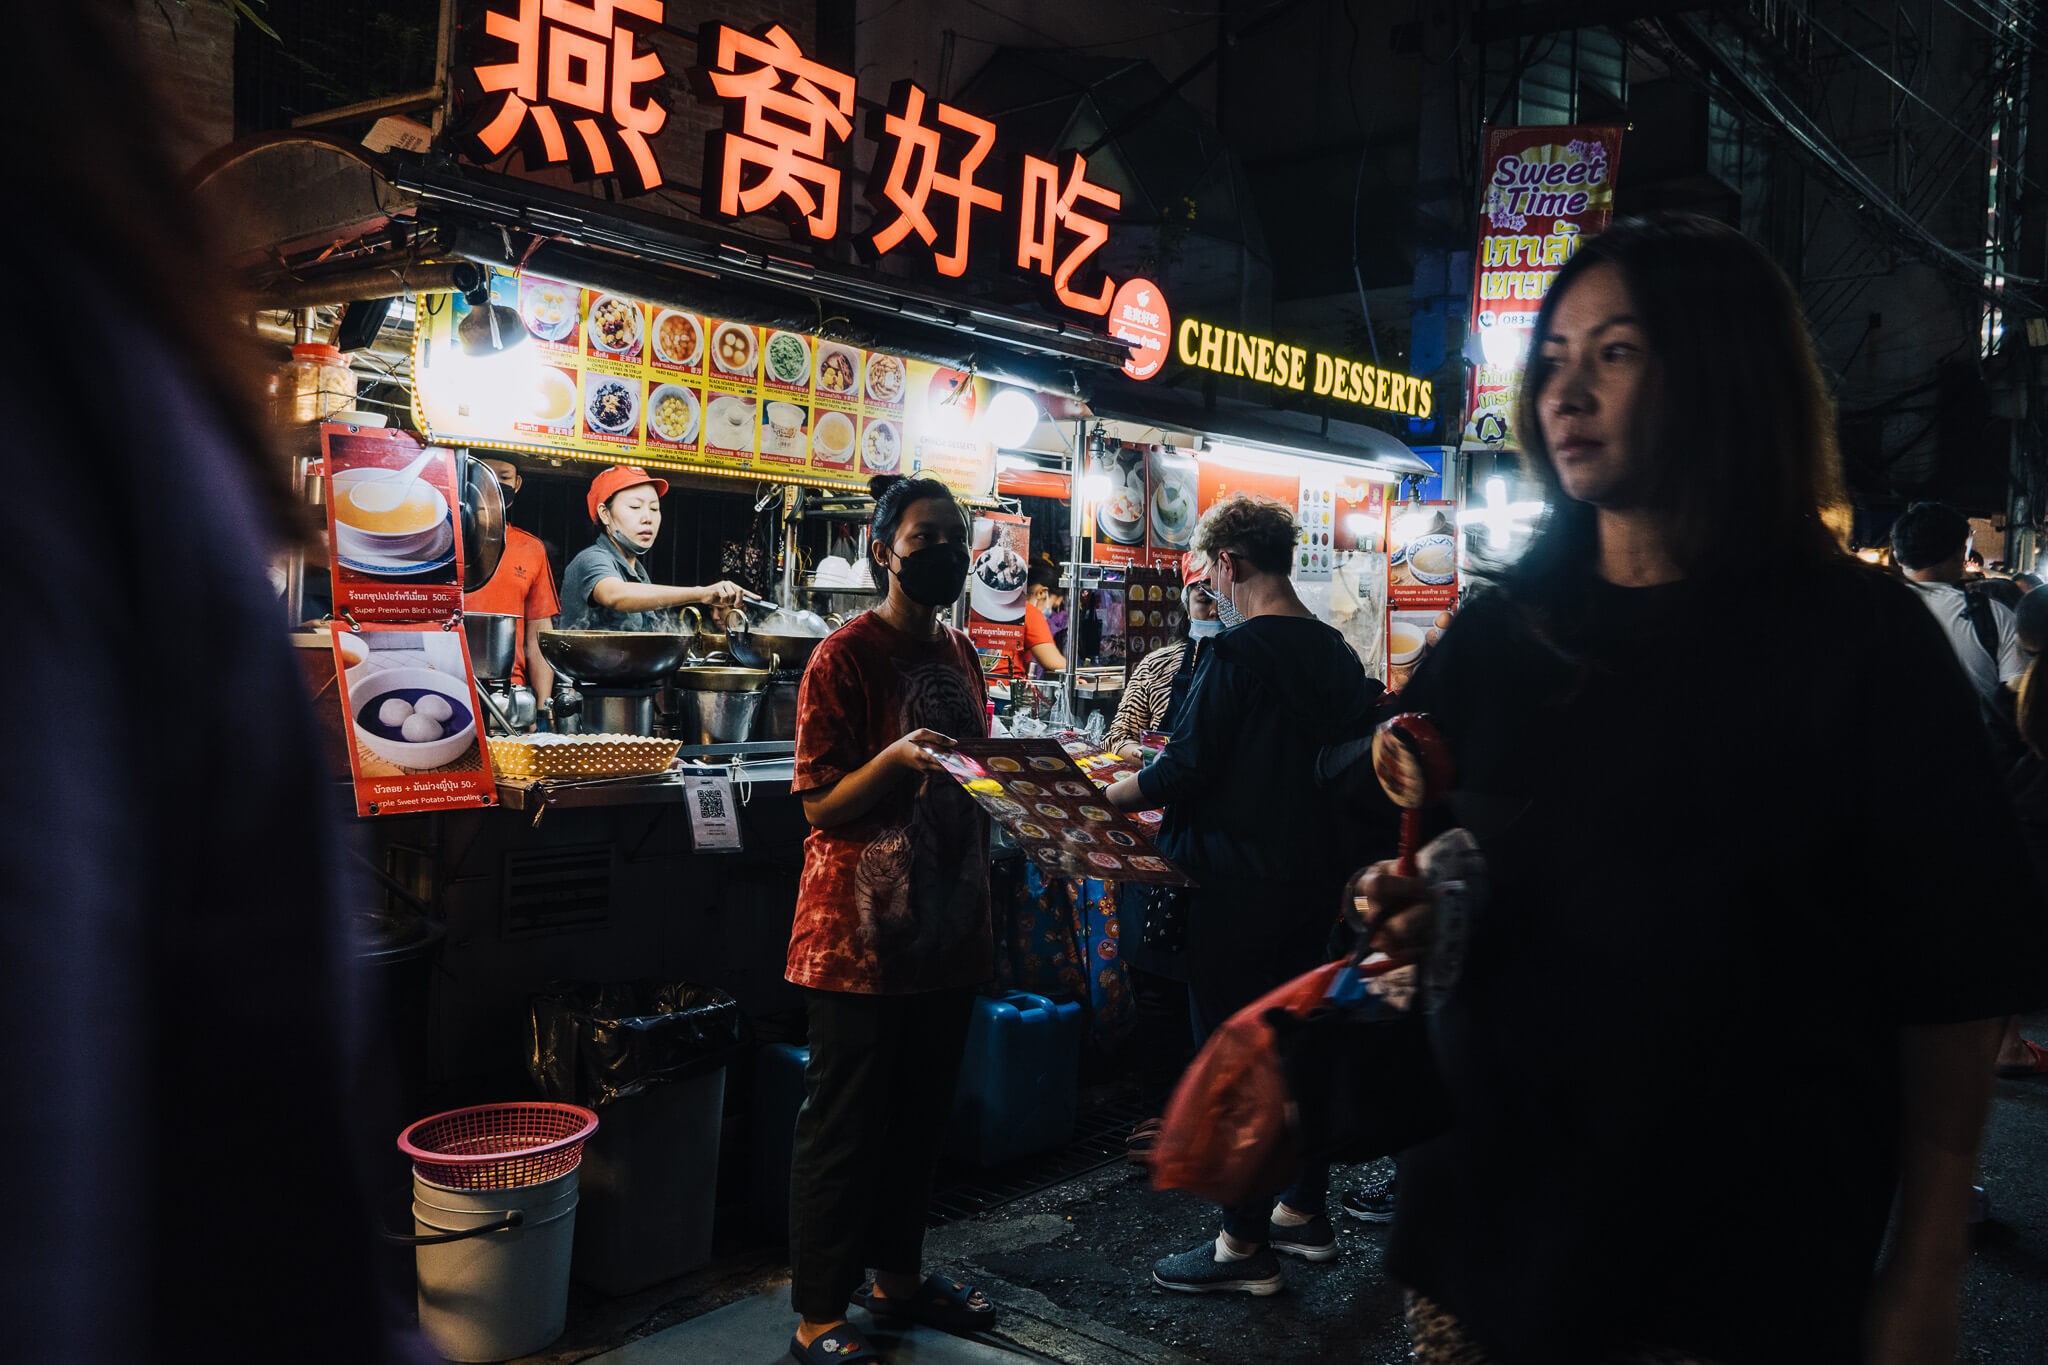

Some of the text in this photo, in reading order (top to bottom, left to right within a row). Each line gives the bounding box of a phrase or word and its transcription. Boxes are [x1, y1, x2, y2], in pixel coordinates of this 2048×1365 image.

[474, 0, 1121, 316] 燕窝好吃
[1492, 154, 1606, 188] Sweet
[1506, 185, 1589, 216] Time
[1503, 315, 1537, 325] 083-8
[1178, 318, 1433, 418] CHINESE DESSERTS
[432, 593, 451, 601] 500.-
[354, 606, 376, 616] Super
[373, 783, 403, 794] บัวลอย
[413, 778, 459, 793] มันม่วงญี่ปุ่น
[461, 780, 477, 789] 50.-
[397, 798, 419, 806] Sweet
[421, 796, 445, 804] Potato
